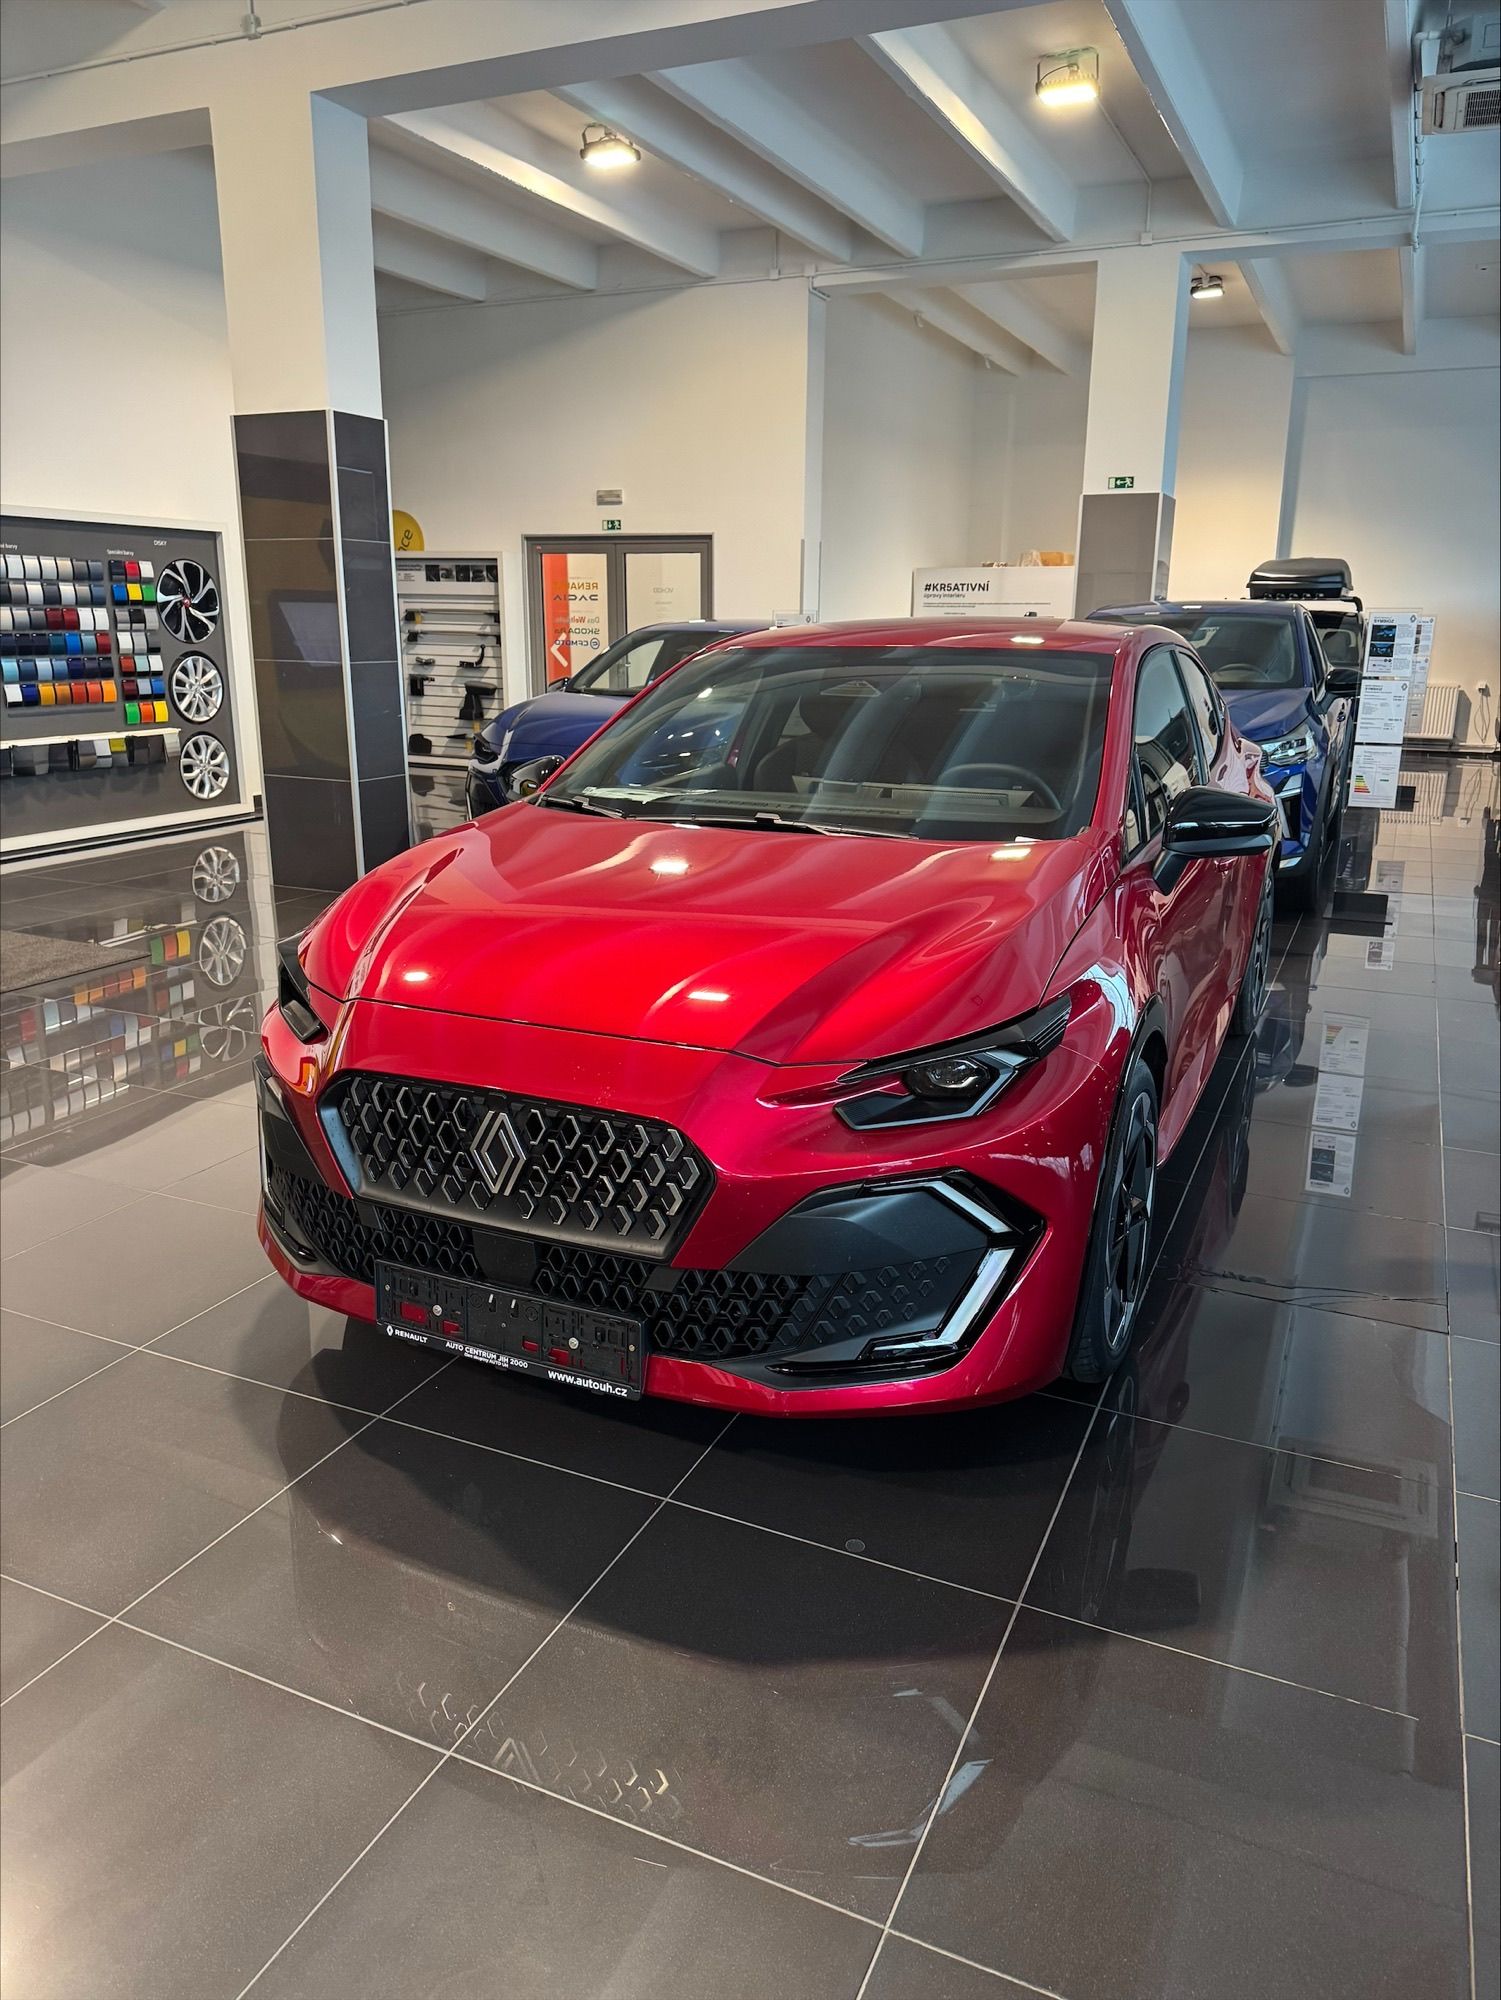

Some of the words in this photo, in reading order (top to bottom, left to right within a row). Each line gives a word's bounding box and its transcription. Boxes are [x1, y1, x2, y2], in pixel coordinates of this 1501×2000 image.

[924, 580, 990, 592] #KR5ATIVNÍ
[394, 1328, 428, 1344] RENAULT
[445, 1341, 464, 1352] AUTO
[464, 1346, 497, 1360] CENTRUM
[498, 1355, 509, 1363] JIH
[510, 1358, 529, 1369] 2000
[547, 1370, 628, 1397] www.autouh.cz
